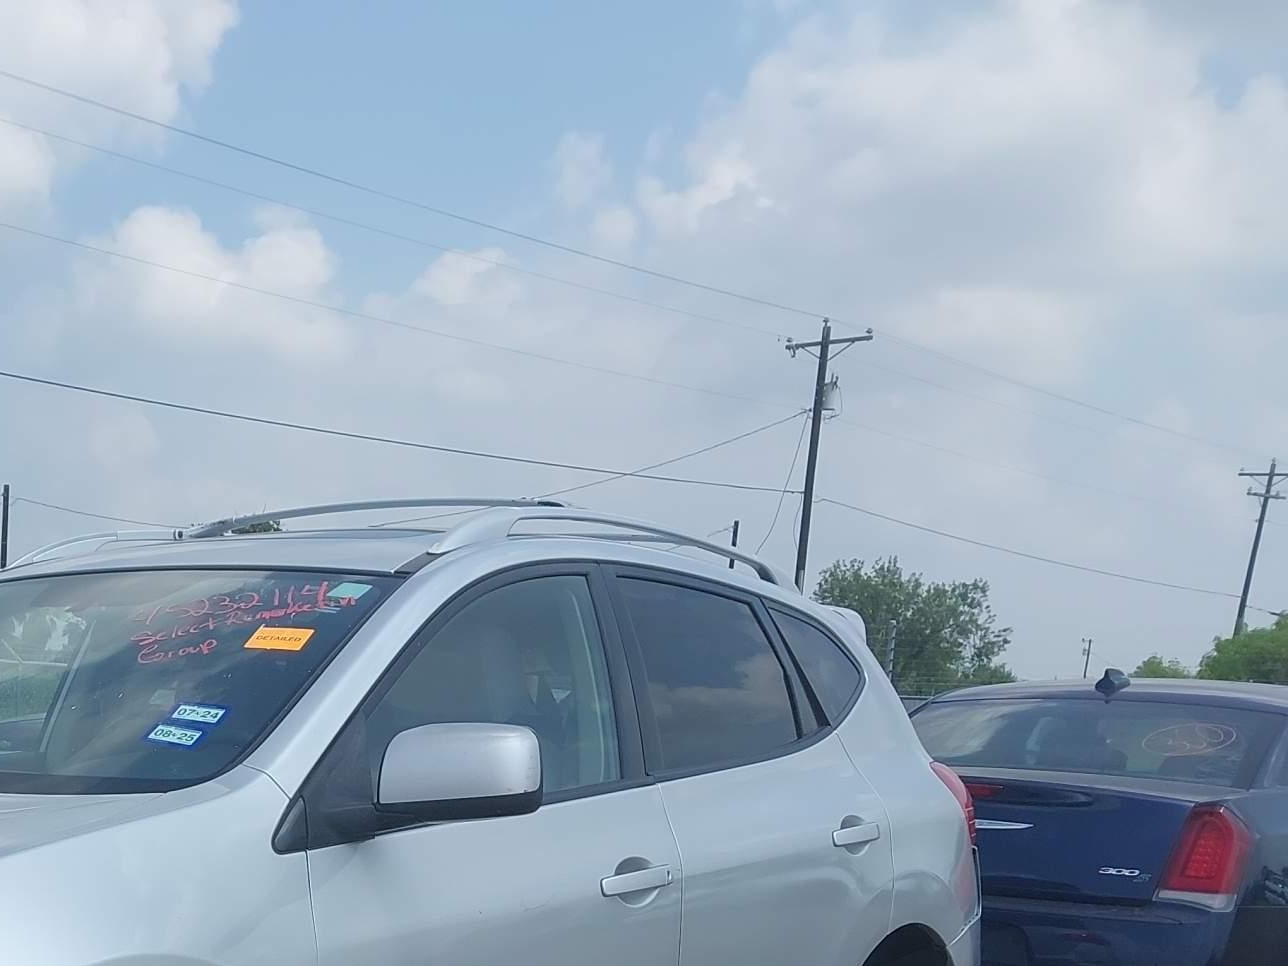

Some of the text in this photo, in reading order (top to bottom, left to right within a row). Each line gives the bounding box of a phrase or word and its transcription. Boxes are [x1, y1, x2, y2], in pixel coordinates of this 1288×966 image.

[131, 618, 217, 646] Select
[255, 634, 302, 643] DETAILED
[137, 639, 217, 664] Group
[1098, 867, 1141, 876] 300
